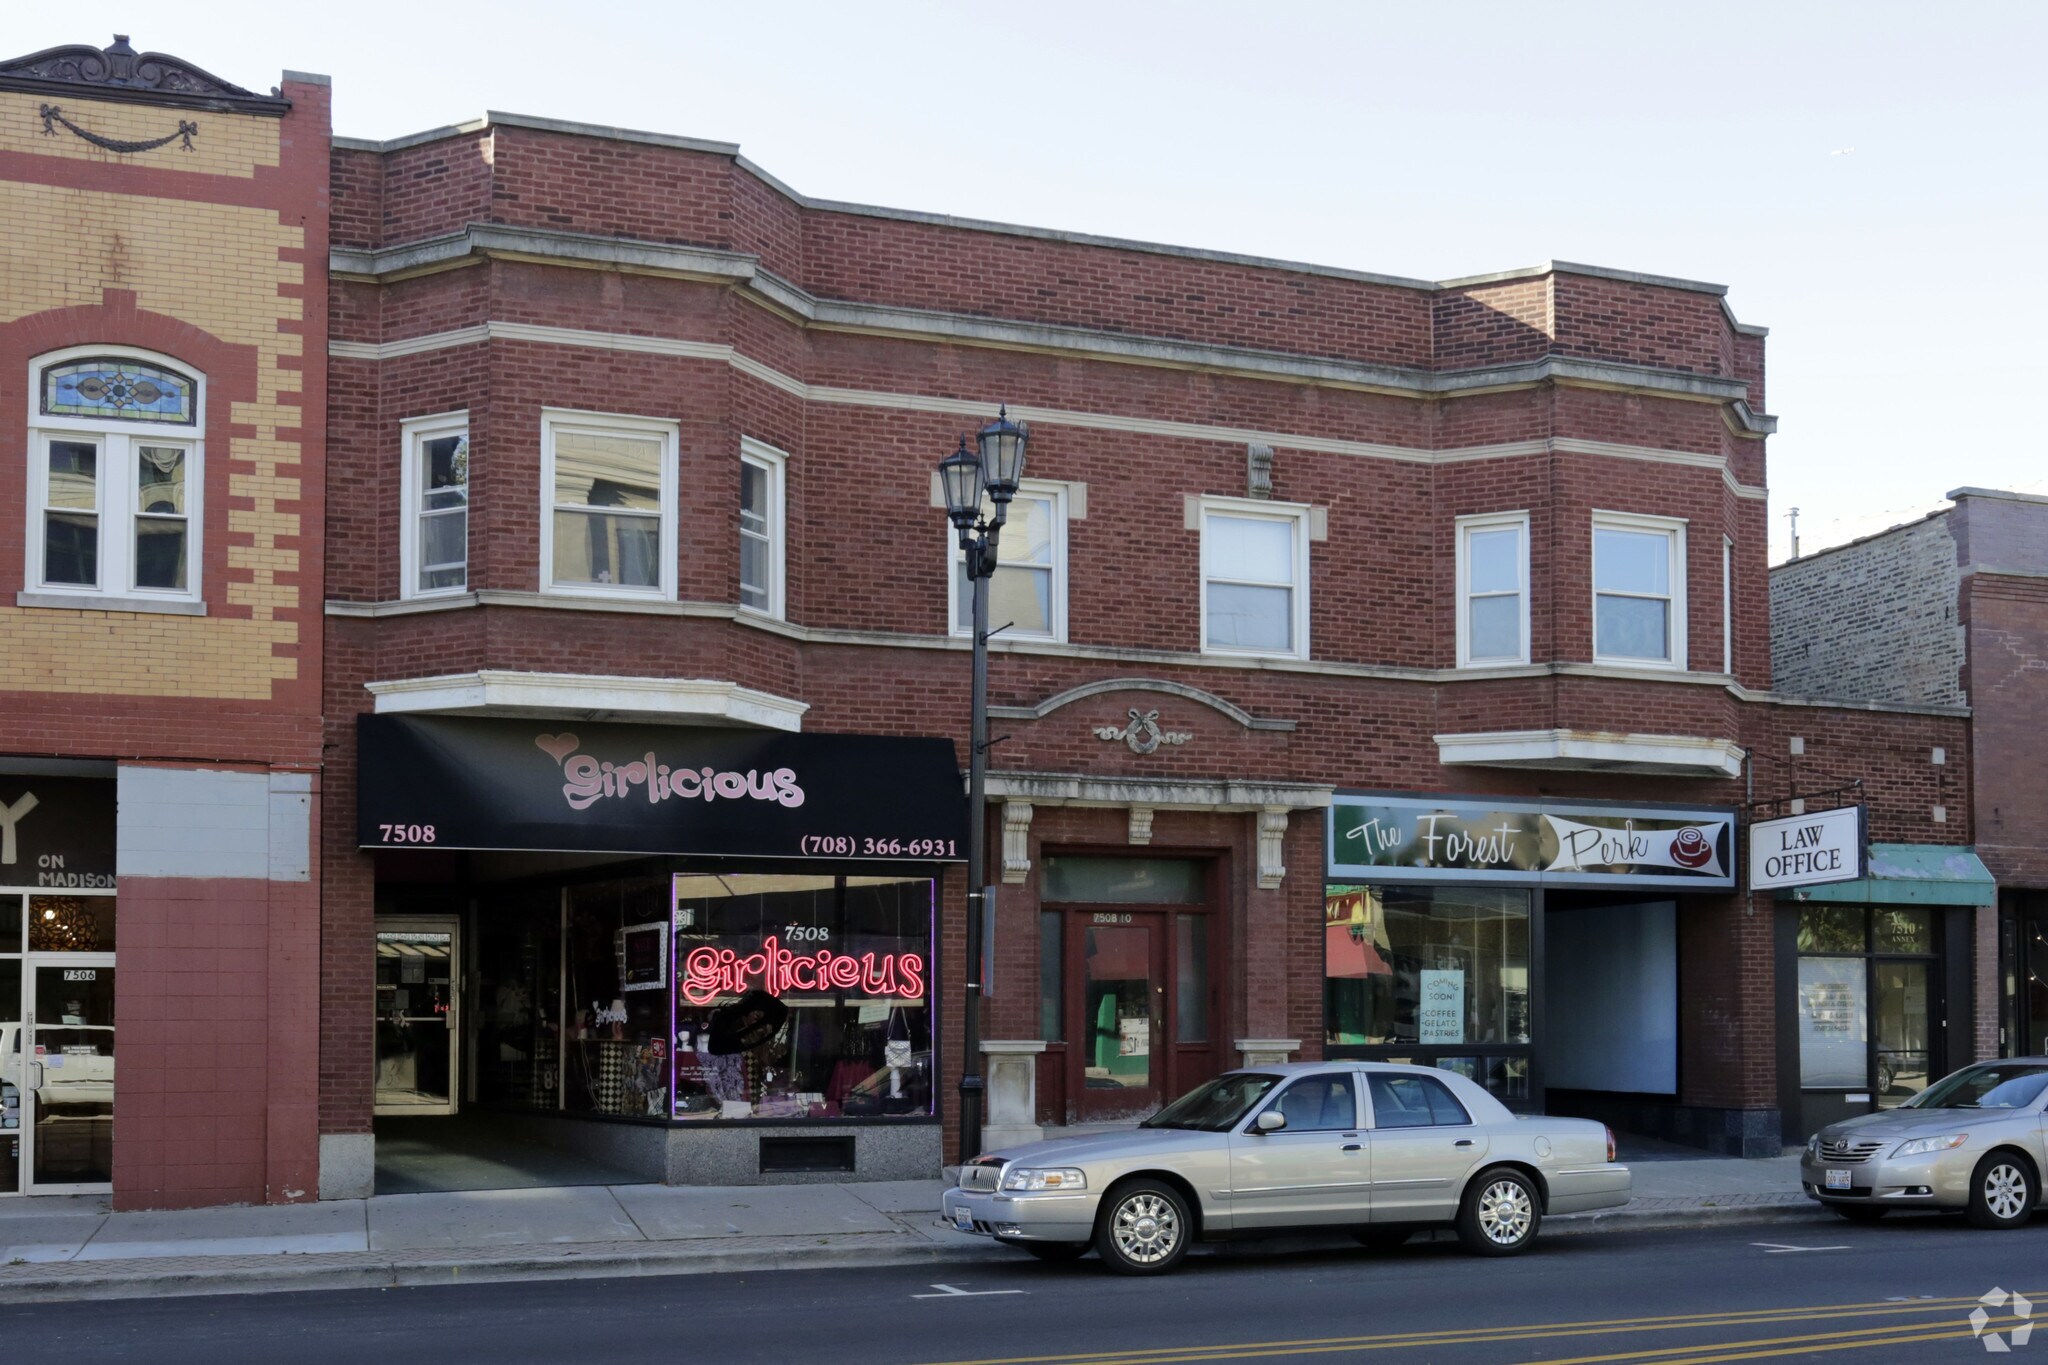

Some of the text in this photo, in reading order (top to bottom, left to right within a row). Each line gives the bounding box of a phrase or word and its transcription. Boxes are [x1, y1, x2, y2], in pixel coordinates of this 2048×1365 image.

[563, 751, 805, 810] Girlicious
[379, 824, 436, 843] 7508
[1780, 824, 1825, 852] LAW
[800, 834, 957, 857] (708) 366-6931
[1346, 814, 1649, 871] The Forest Perk
[38, 854, 65, 869] ON
[1765, 848, 1842, 878] OFFICE
[38, 871, 117, 888] MADISON
[1093, 913, 1118, 923] 7508
[784, 925, 830, 942] 7508
[1890, 922, 1916, 934] 7510
[65, 970, 95, 980] 7506
[1427, 978, 1460, 991] COMING
